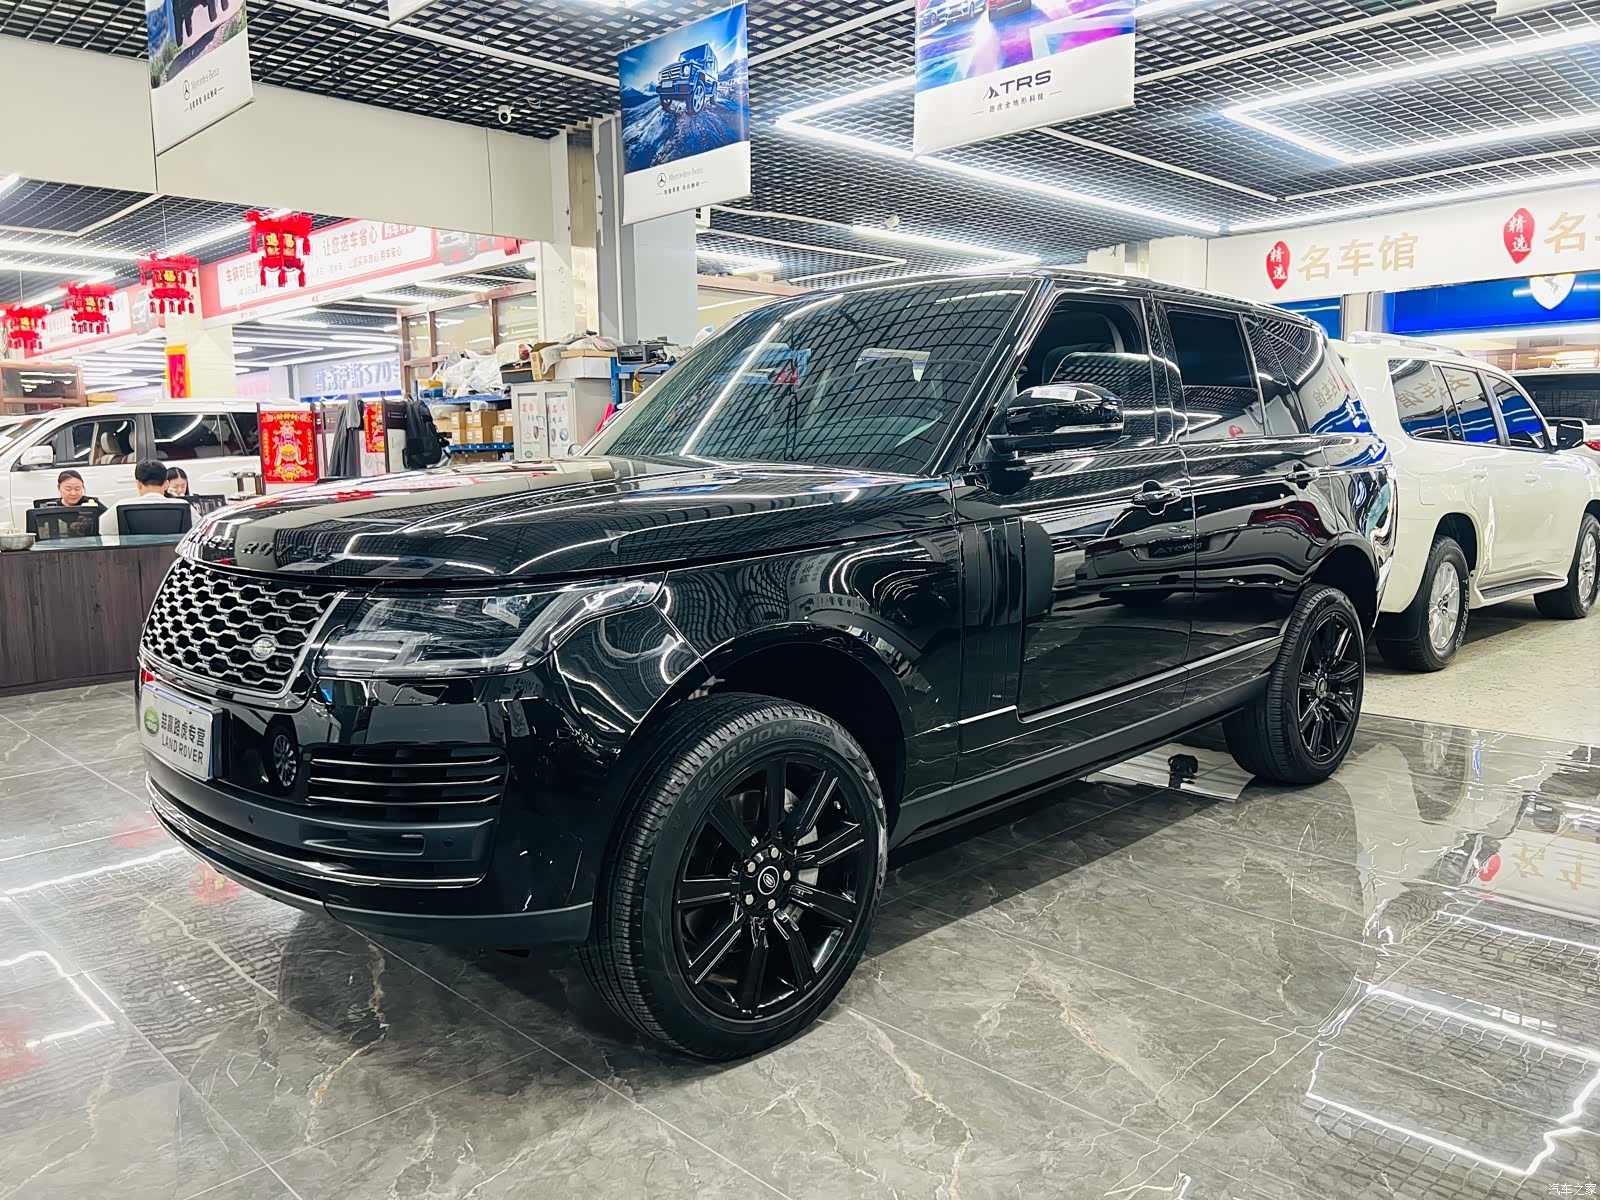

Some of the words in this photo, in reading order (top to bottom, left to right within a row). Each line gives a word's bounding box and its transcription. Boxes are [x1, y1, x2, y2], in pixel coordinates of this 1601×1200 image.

[989, 93, 1044, 112] 路虎全地形科技
[1508, 215, 1532, 253] 精选
[1544, 211, 1601, 254] 名
[1270, 248, 1287, 280] 精选
[1297, 232, 1418, 281] 名车馆
[161, 733, 178, 752] LAND
[178, 743, 204, 765] ROVER
[685, 724, 788, 805] SCORPION
